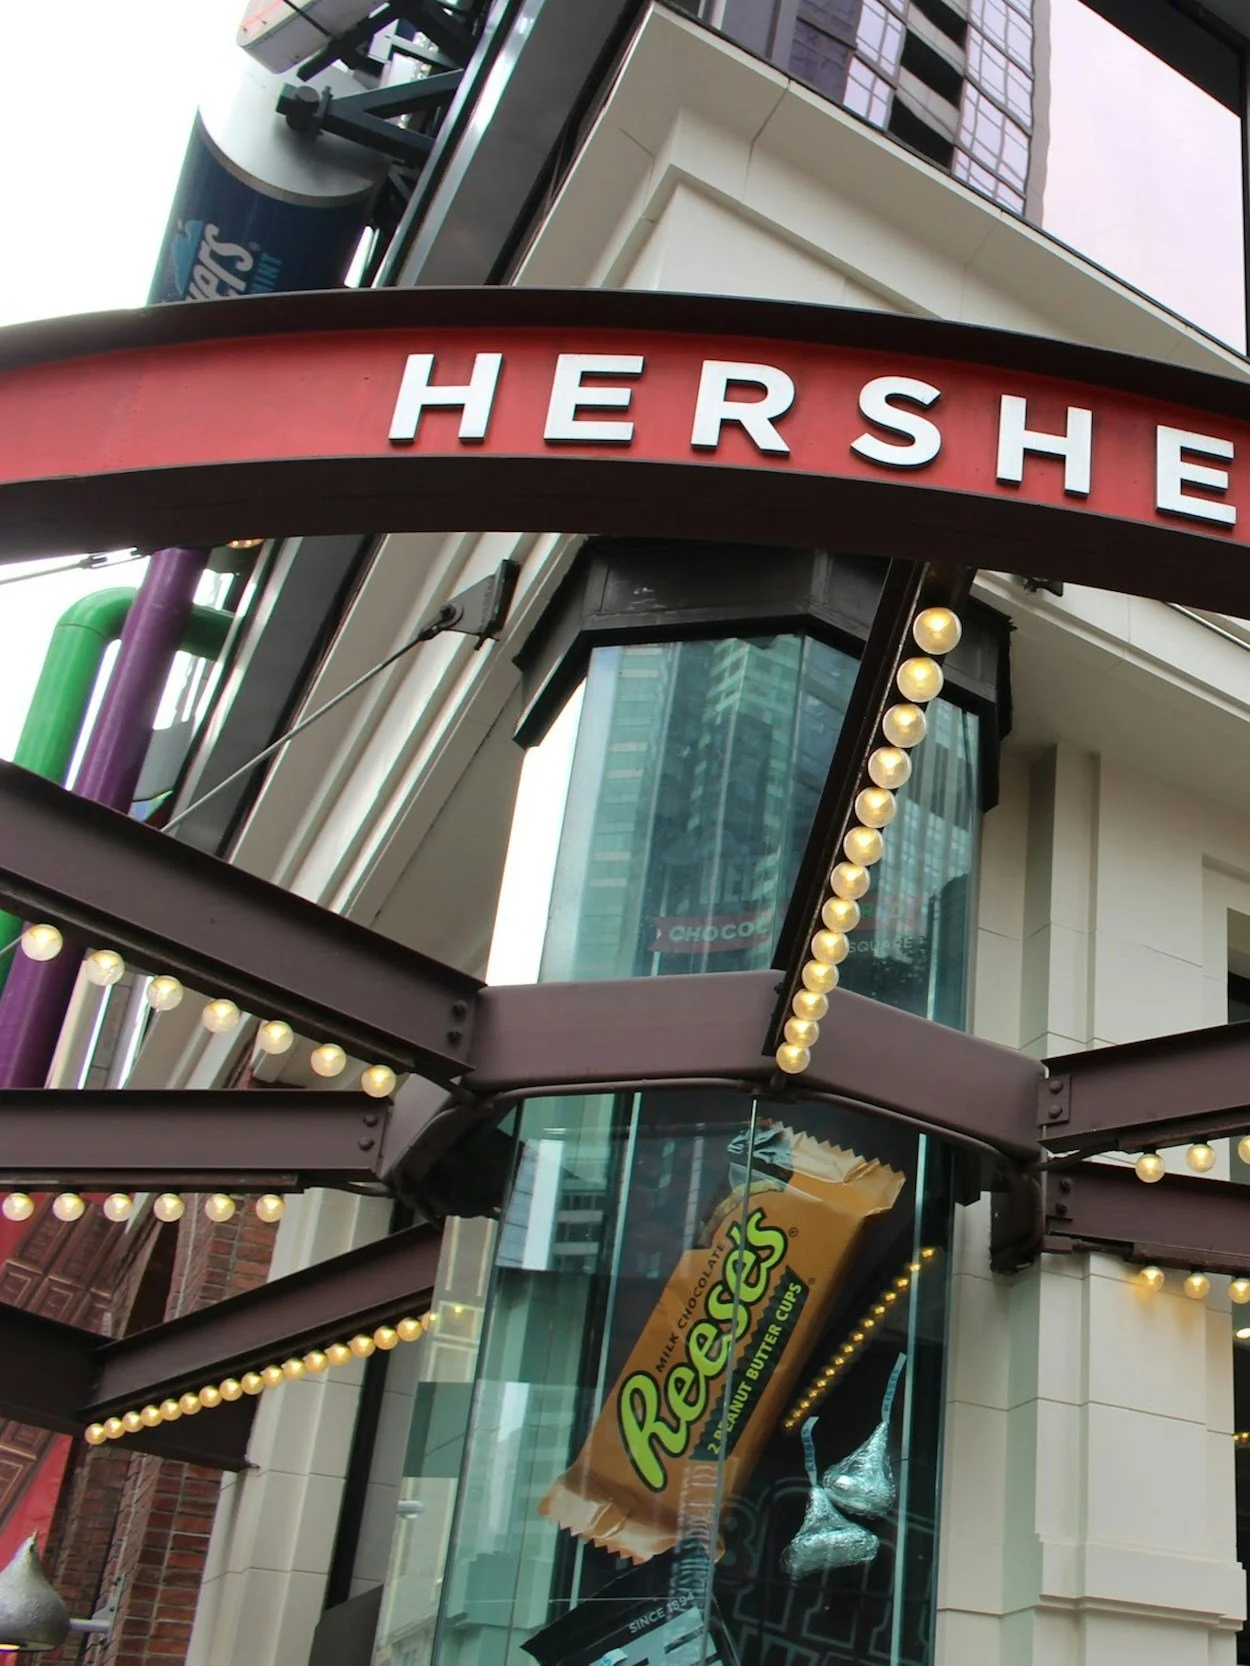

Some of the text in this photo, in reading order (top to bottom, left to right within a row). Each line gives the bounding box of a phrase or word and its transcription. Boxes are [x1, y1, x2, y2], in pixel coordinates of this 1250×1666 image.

[617, 1207, 788, 1493] Reese's
[655, 1241, 726, 1374] MILK CHOCOLATE
[707, 1281, 803, 1455] 2 PEANUT BUTTER CUPS
[628, 1607, 667, 1634] SINCE
